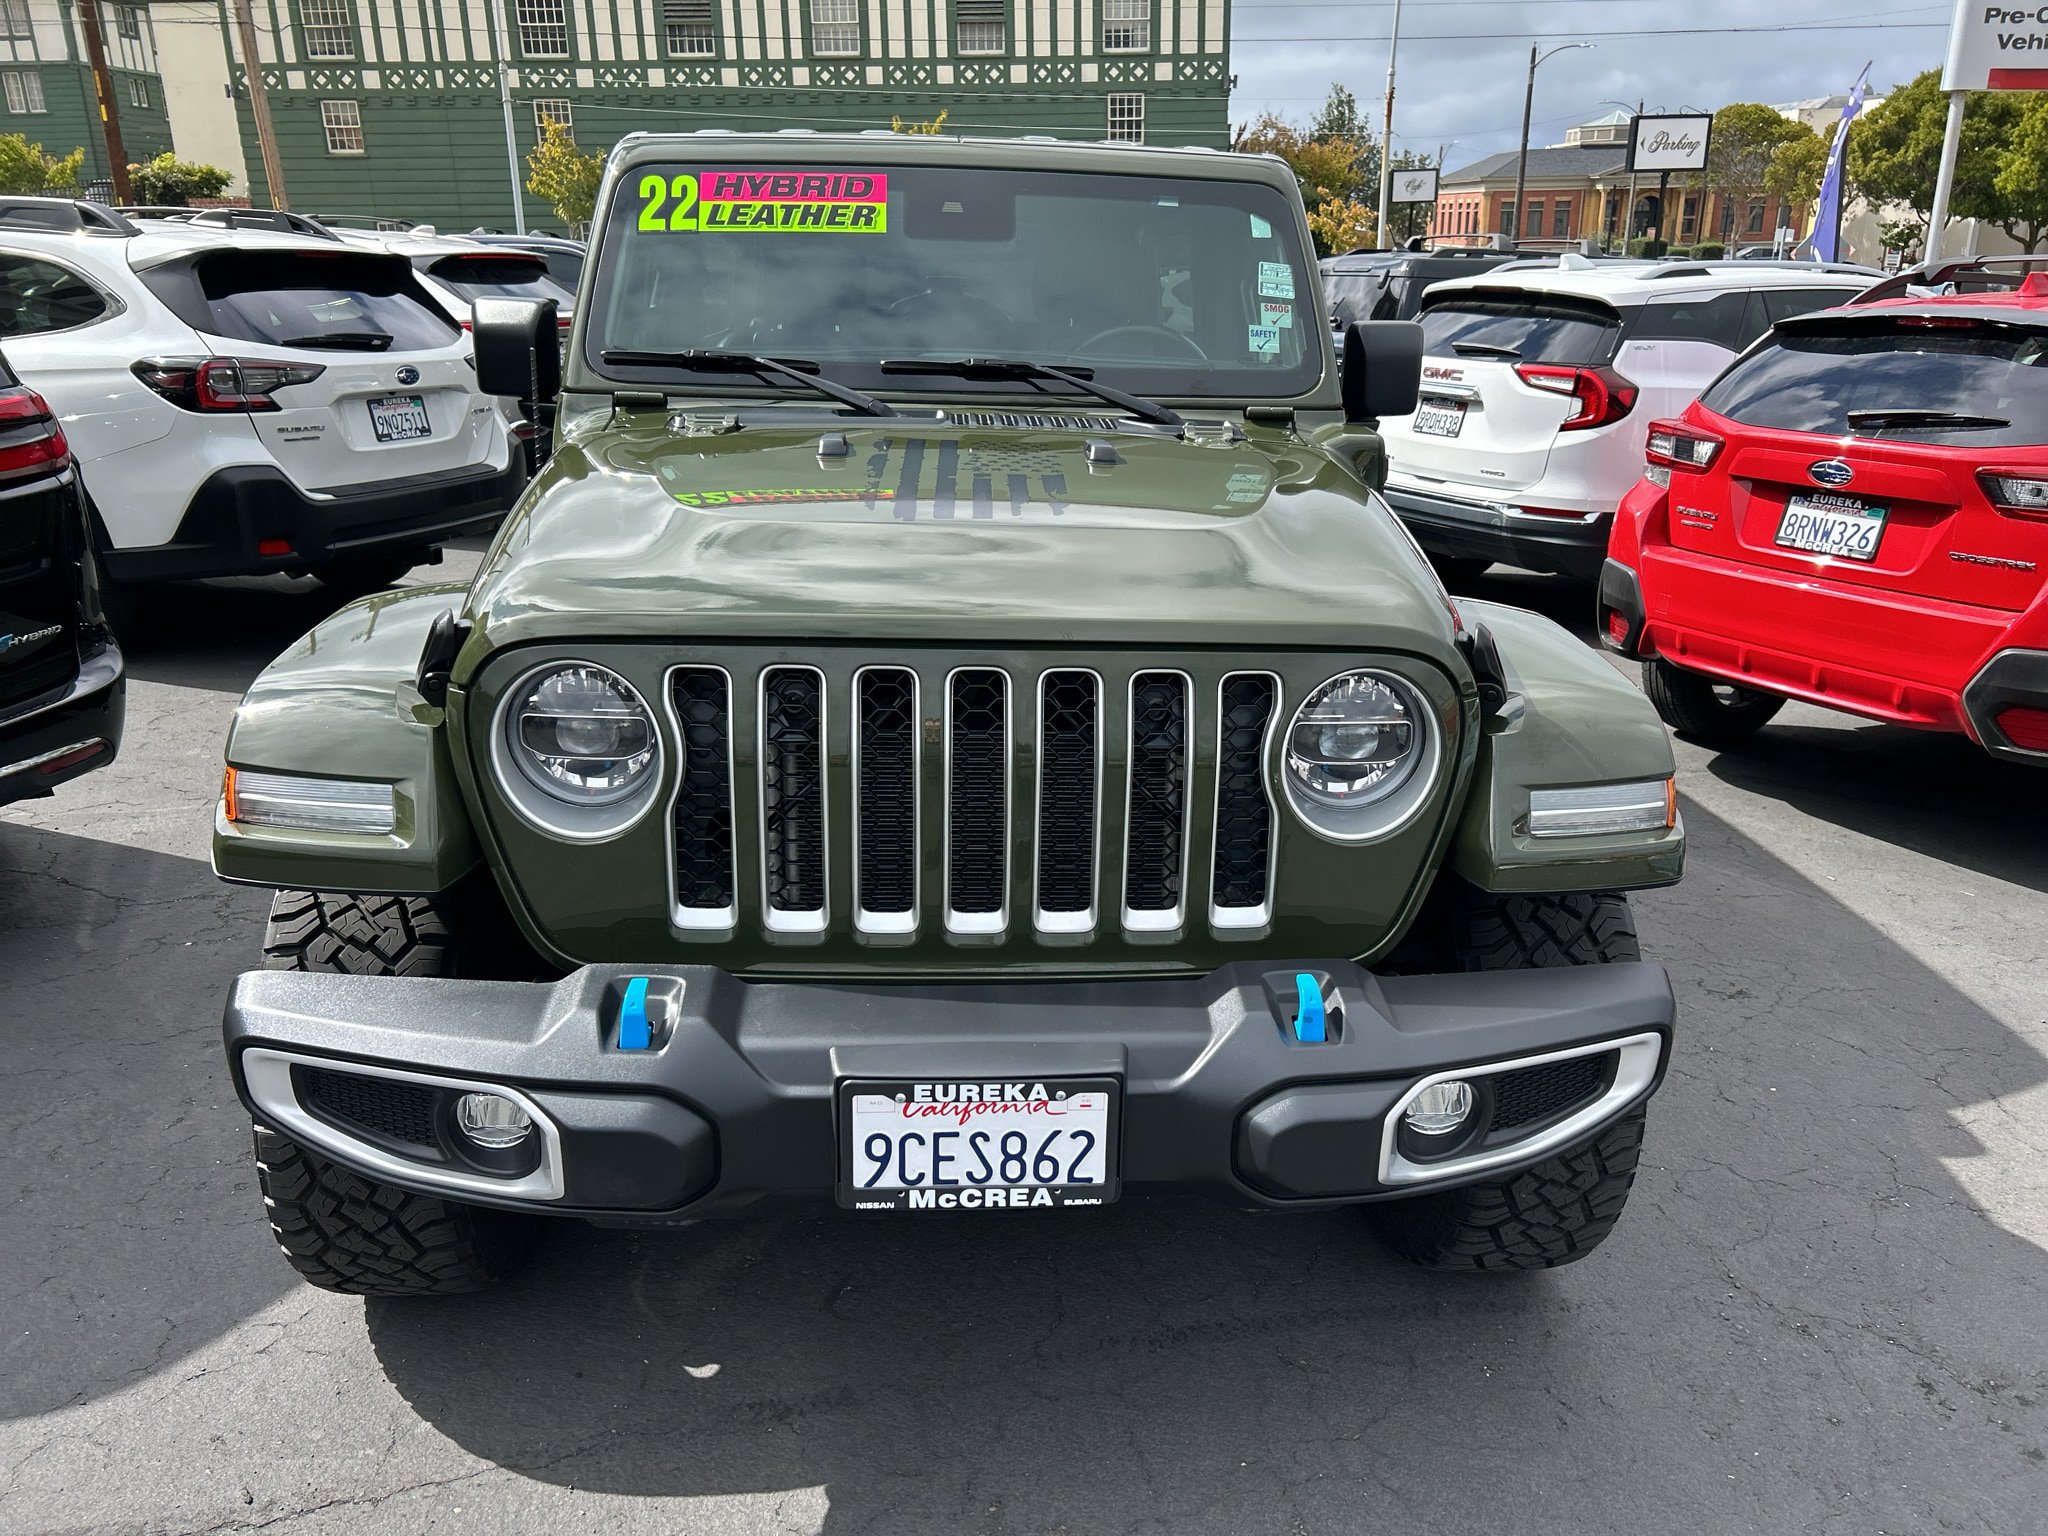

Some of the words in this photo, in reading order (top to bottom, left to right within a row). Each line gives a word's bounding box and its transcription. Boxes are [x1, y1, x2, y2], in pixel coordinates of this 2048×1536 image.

[1648, 130, 1701, 157] Parking
[713, 174, 877, 200] HYBRID
[638, 174, 699, 231] 22
[706, 203, 880, 229] LEATHER
[1264, 304, 1290, 313] SMOG
[1250, 329, 1277, 339] SAFETY
[1423, 367, 1464, 381] GMC
[277, 425, 326, 433] SUBARU
[1812, 494, 1862, 509] EUREKA
[1784, 513, 1876, 549] 8RNW326
[1794, 539, 1849, 557] McCREA
[1948, 551, 2037, 571] CROSSTREK
[8, 624, 62, 647] HYBRID
[914, 1083, 1049, 1102] EUREKA
[902, 1100, 1067, 1126] California
[864, 1130, 1096, 1188] 9CES862
[855, 1202, 895, 1210] NISSAN
[909, 1187, 1053, 1209] McCREA
[1063, 1198, 1102, 1206] SUBARU
